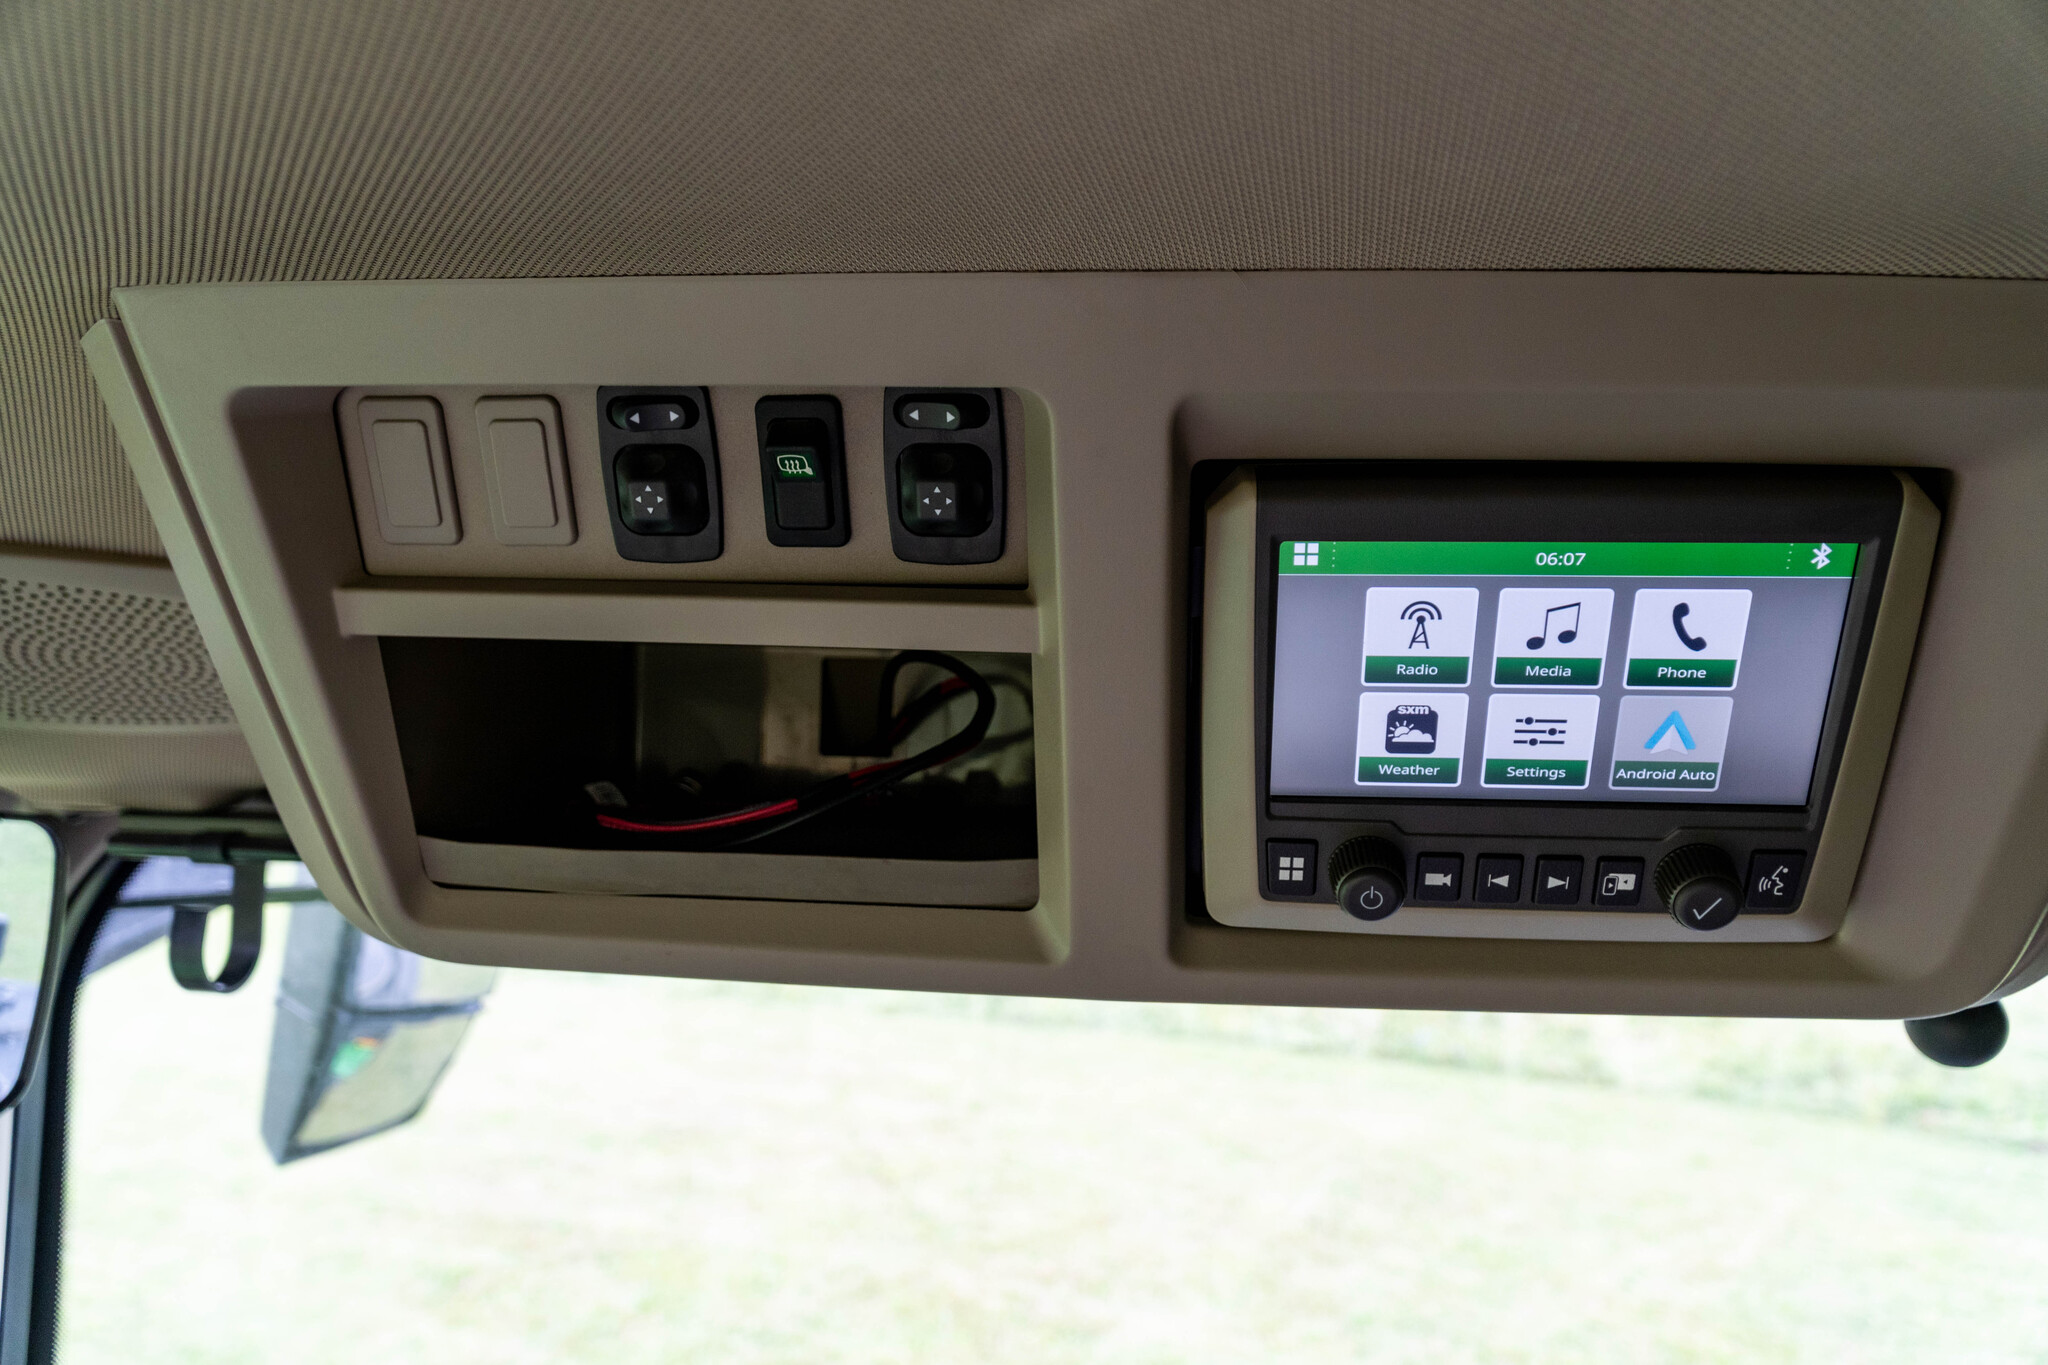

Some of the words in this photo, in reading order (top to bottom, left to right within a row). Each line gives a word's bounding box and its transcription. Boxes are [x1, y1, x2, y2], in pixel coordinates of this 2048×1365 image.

[1535, 552, 1586, 566] 06:07
[1396, 664, 1438, 676] Radio
[1525, 665, 1572, 677] Media
[1657, 666, 1707, 678] Phone
[1397, 705, 1429, 715] sxm
[1377, 764, 1440, 776] Weather
[1506, 766, 1566, 780] Settings
[1615, 768, 1676, 780] Android
[1679, 769, 1716, 781] Auto
